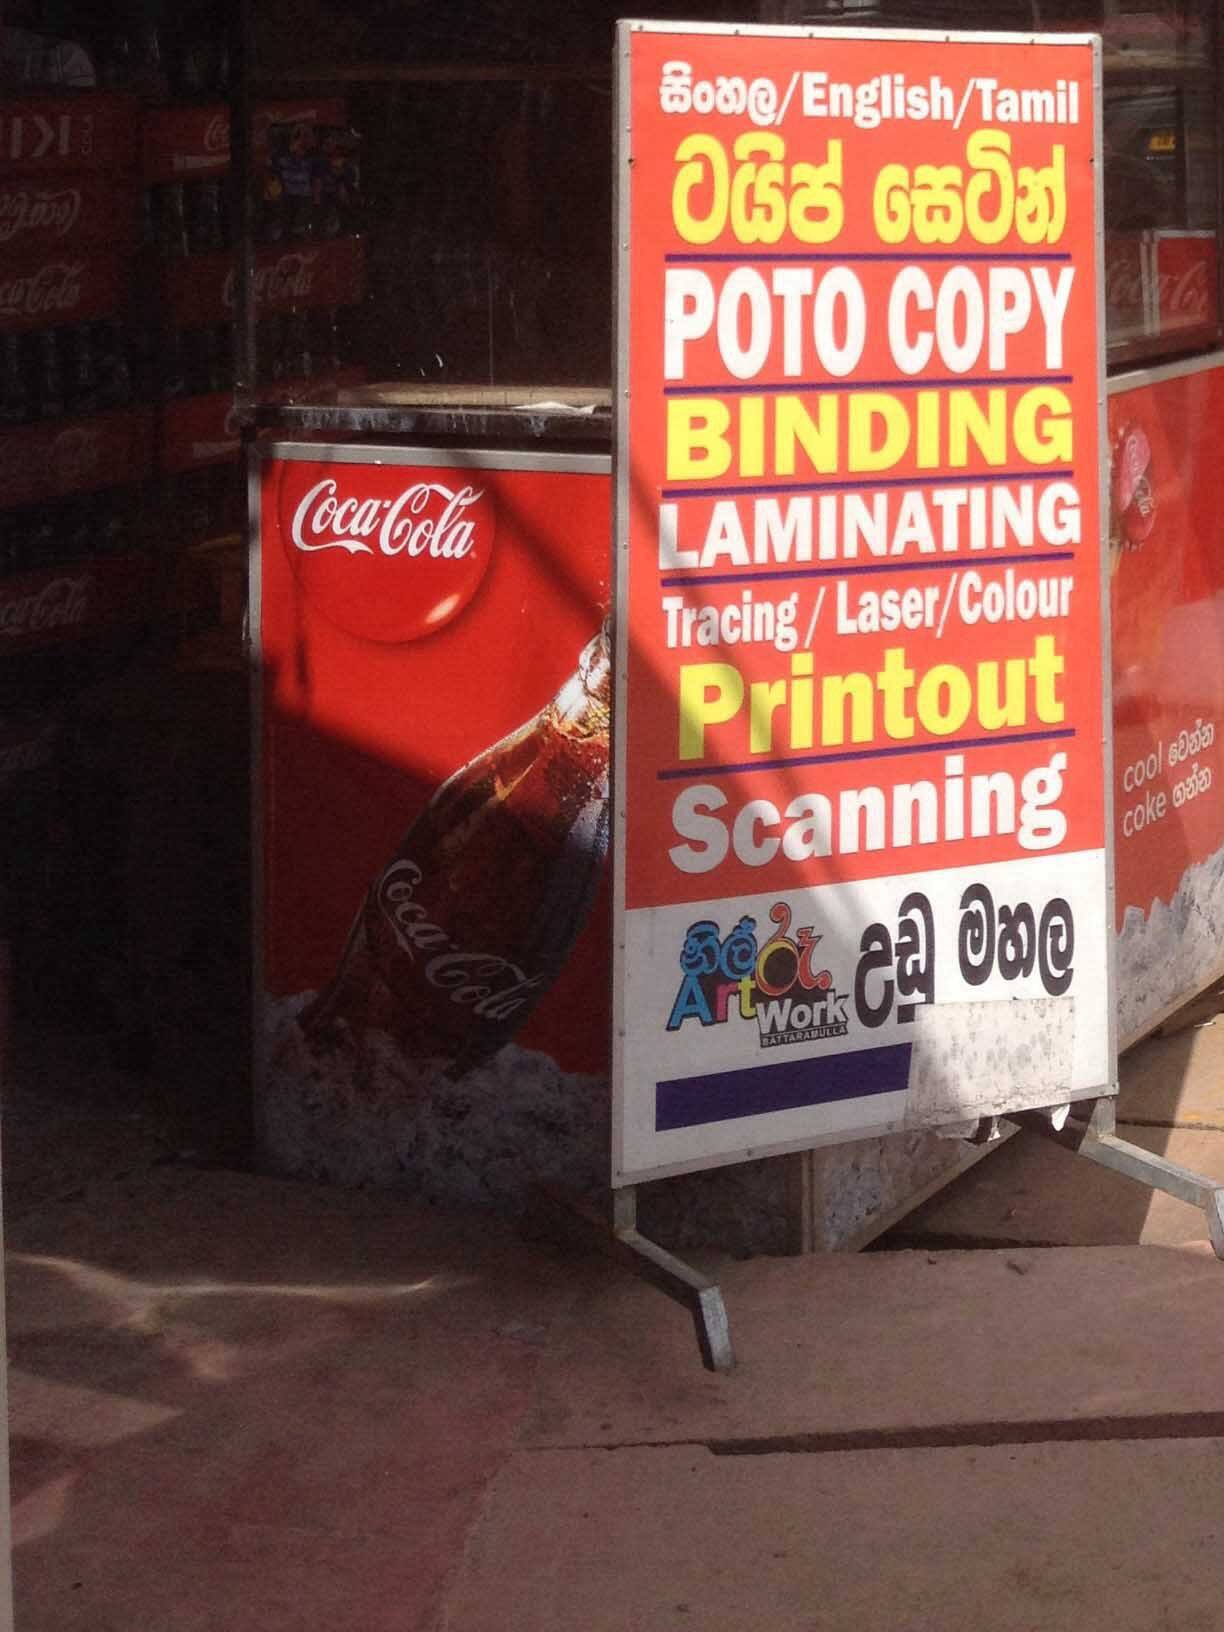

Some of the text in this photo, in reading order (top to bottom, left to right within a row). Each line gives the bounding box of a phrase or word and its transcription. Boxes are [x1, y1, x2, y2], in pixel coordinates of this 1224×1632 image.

[672, 129, 1067, 244] ටයිප් සෙටින්
[664, 266, 867, 380] POTO
[887, 266, 1076, 374] COPY
[666, 386, 1073, 480] BINDING
[291, 479, 485, 559] Coca-Cola
[658, 484, 1081, 570] LAMINATING
[662, 593, 798, 651] Tracing
[678, 635, 1065, 760] Printout
[1123, 718, 1214, 793] cool වෙන්න
[668, 752, 1067, 874] Scanning
[1123, 794, 1166, 838] coke
[378, 860, 544, 1020] Coca-Cola
[958, 882, 1075, 996] මහල
[666, 974, 756, 1030] Art
[756, 990, 850, 1035] Work
